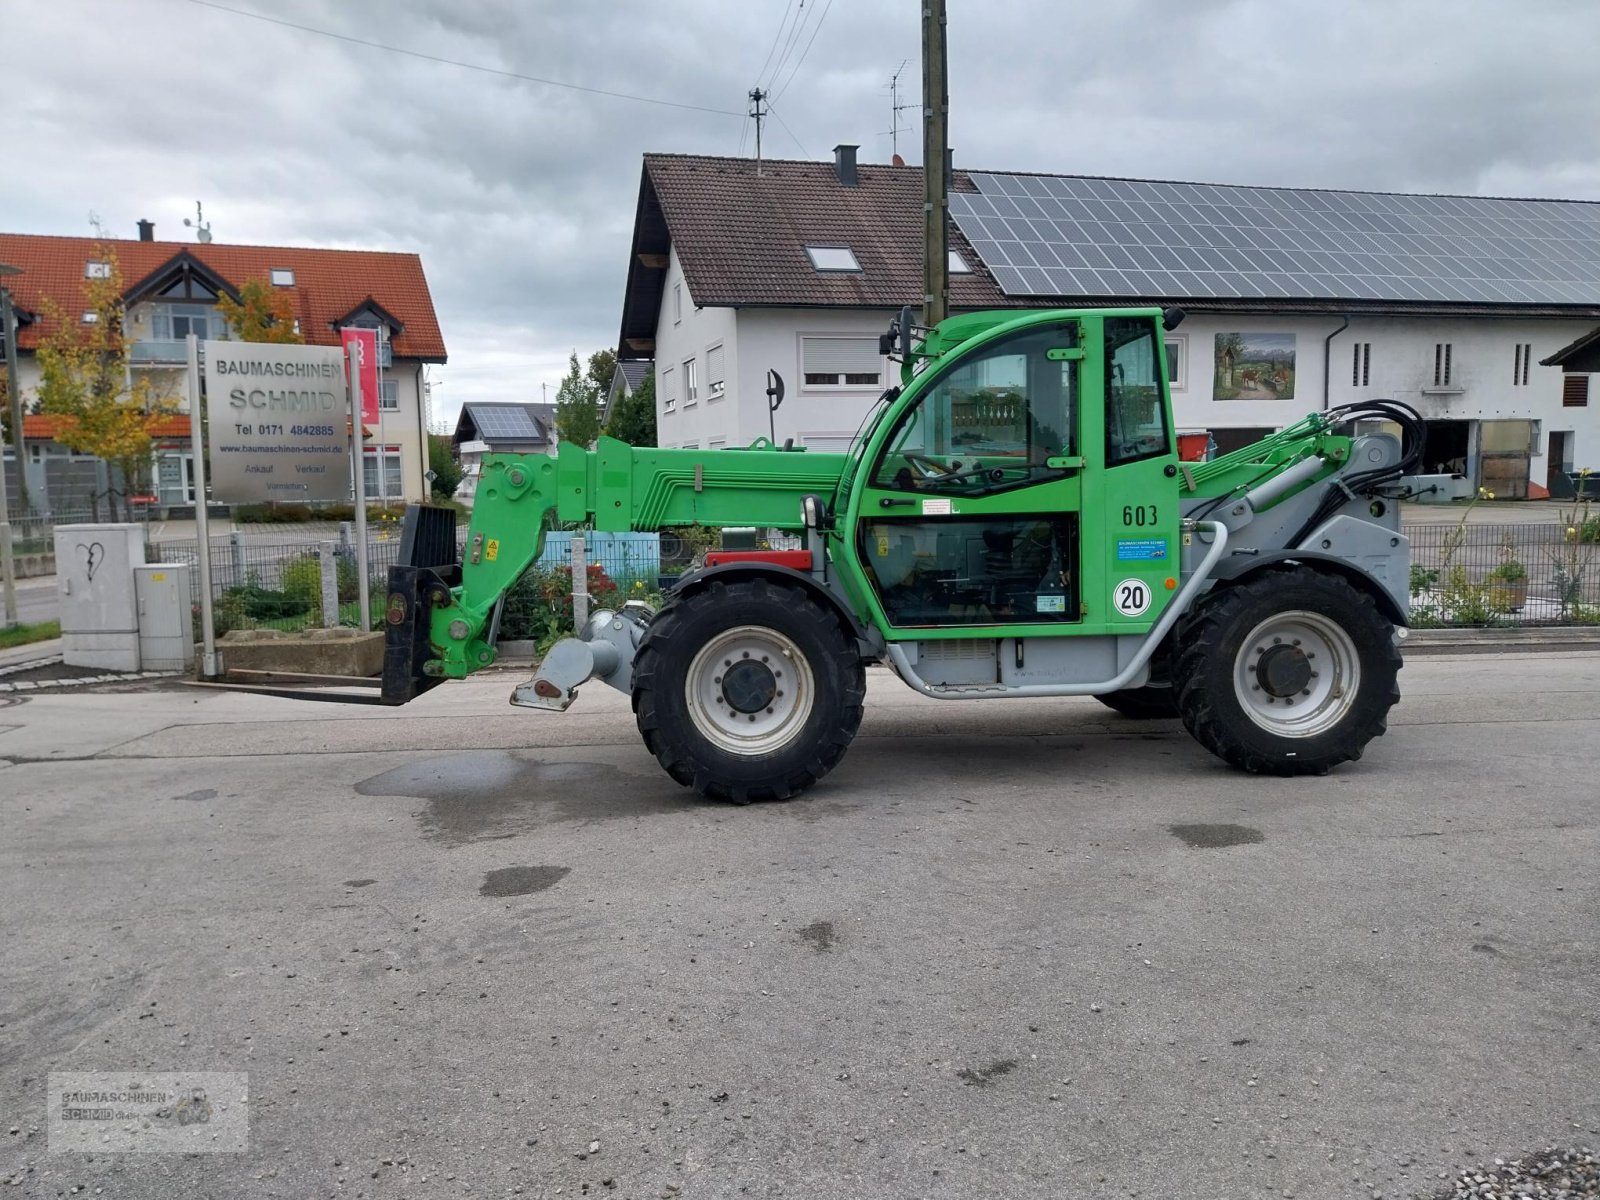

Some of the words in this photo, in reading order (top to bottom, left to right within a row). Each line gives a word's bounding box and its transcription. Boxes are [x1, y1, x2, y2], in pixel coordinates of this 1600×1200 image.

[216, 360, 341, 379] BAUMASCHINEN
[229, 388, 338, 412] SCHMID
[235, 423, 252, 436] Tel
[258, 424, 284, 436] 0171
[290, 425, 335, 437] 4842885
[219, 444, 343, 454] www.baumaschinen-schmid.de
[244, 464, 274, 474] Ankauf
[295, 464, 326, 474] Verkauf
[1122, 505, 1158, 527] 603
[1121, 586, 1144, 609] 20
